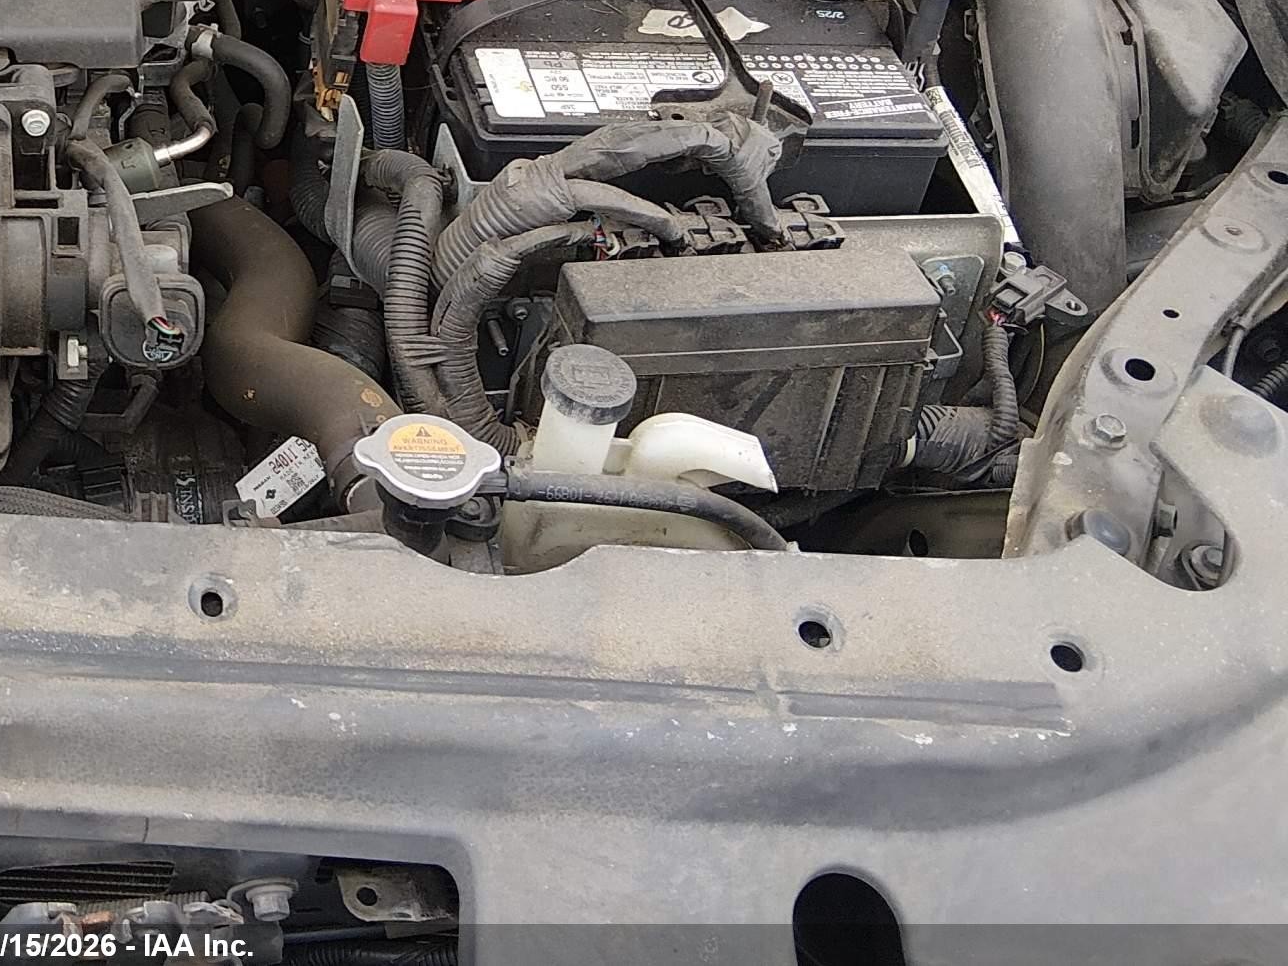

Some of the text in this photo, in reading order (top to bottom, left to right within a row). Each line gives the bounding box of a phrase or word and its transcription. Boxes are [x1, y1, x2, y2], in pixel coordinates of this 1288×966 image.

[815, 9, 845, 19] 2/25
[544, 60, 562, 68] Pb
[849, 98, 893, 109] BATTERY
[402, 437, 448, 445] WARNING
[393, 445, 460, 453] AVERTISSEMENT
[268, 447, 299, 474] 24011
